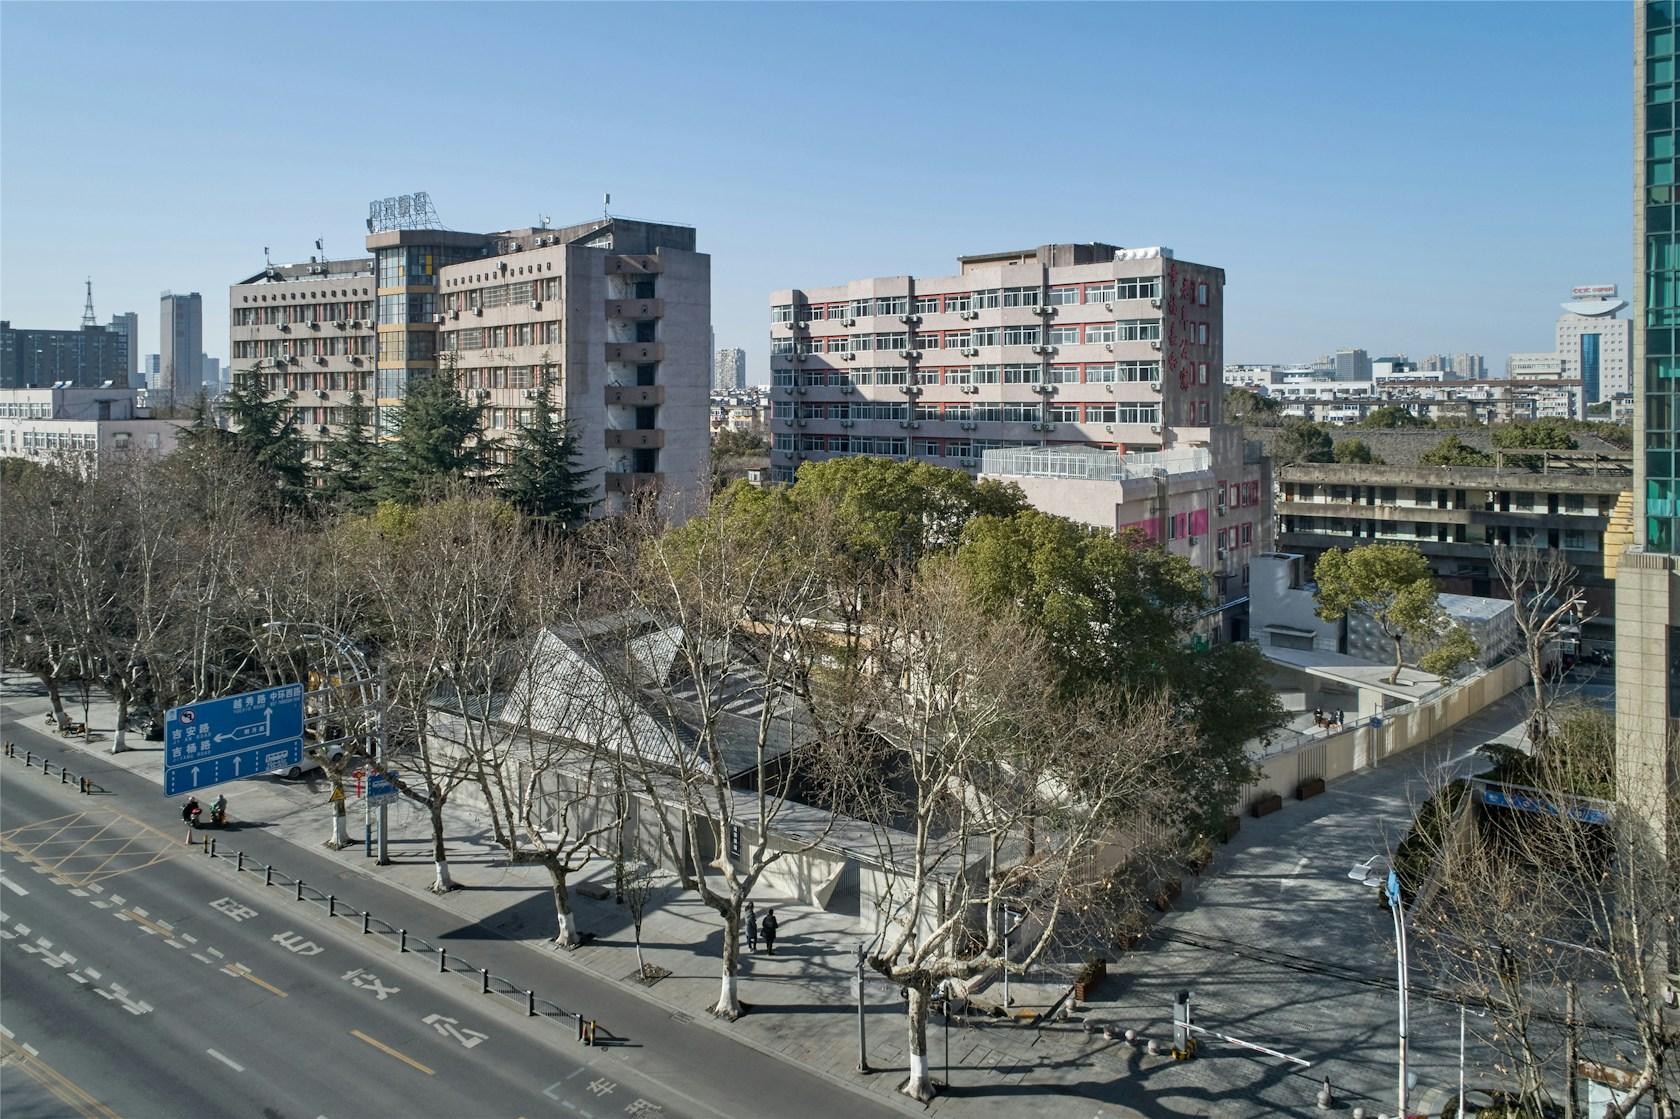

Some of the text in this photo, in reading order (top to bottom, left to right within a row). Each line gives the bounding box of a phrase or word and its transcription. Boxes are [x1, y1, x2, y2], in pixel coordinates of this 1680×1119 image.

[233, 694, 266, 709] 越秀路
[270, 687, 300, 701] 中环西路
[172, 723, 209, 740] 吉安路
